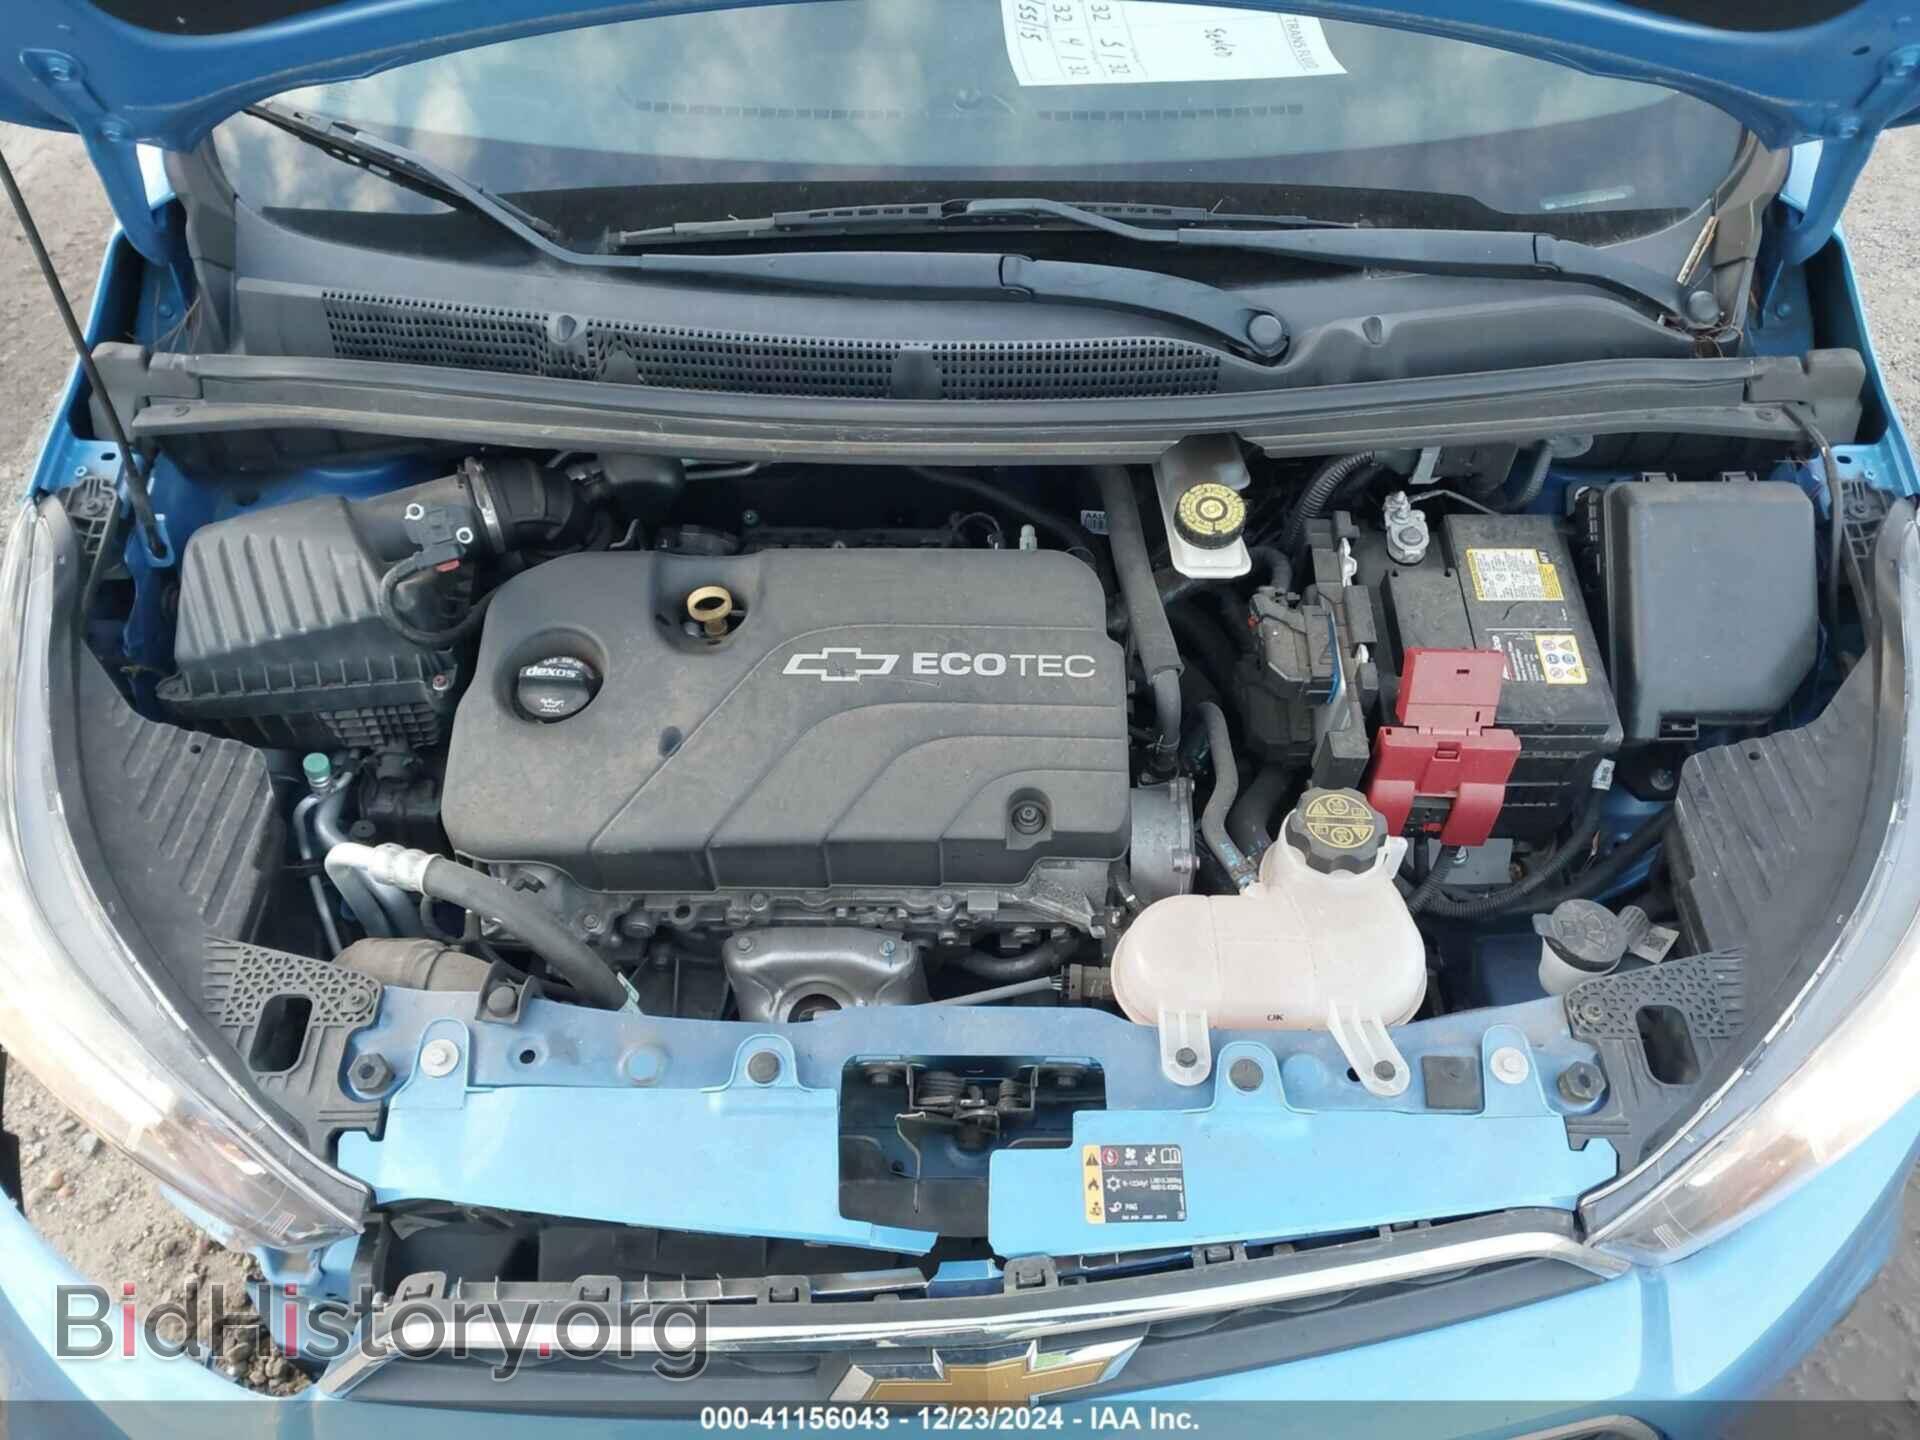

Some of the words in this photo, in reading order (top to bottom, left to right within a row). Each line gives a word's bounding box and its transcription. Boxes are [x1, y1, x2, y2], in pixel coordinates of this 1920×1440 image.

[1053, 4, 1073, 22] 32
[1091, 4, 1111, 22] 32
[1285, 17, 1307, 48] TRANS
[526, 666, 580, 678] dexos
[912, 652, 1096, 677] ECOTEC
